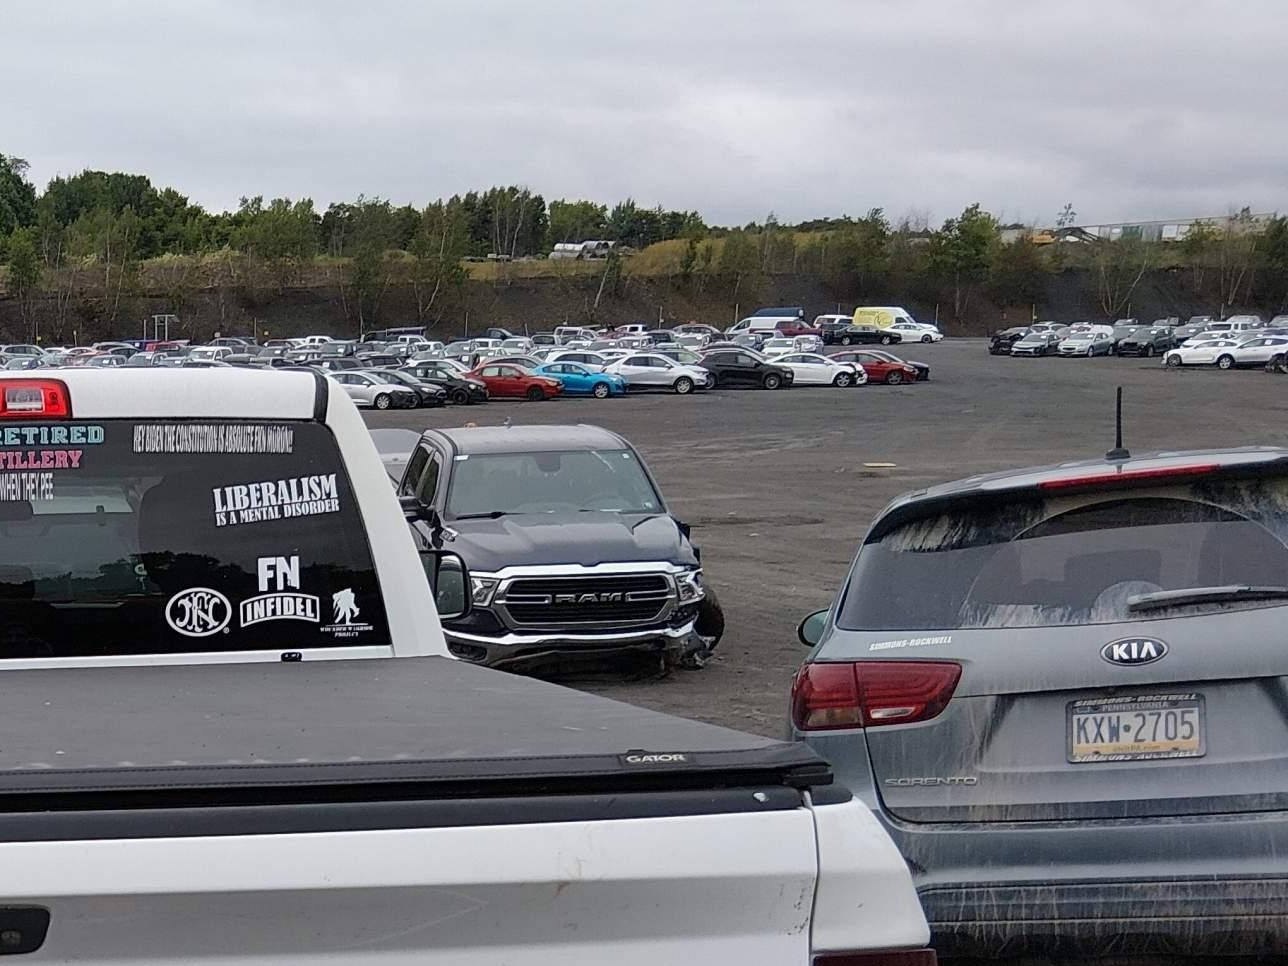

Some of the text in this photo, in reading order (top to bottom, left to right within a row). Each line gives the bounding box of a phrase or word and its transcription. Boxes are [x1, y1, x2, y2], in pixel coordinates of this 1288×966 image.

[133, 425, 145, 452] HEY
[165, 425, 175, 452] THE
[176, 425, 217, 452] CONSTITUTION
[0, 472, 20, 501] WHEN
[22, 472, 39, 500] THEY
[41, 472, 53, 500] PEE
[213, 473, 338, 512] LIBERALISM
[216, 499, 339, 526] IS A MENTAL DISORDER
[258, 556, 300, 592] FN
[246, 596, 315, 622] INFIDEL
[554, 592, 624, 605] RAM
[1113, 641, 1157, 660] KIA
[626, 754, 686, 763] GATOR
[885, 777, 977, 786] SORENTO
